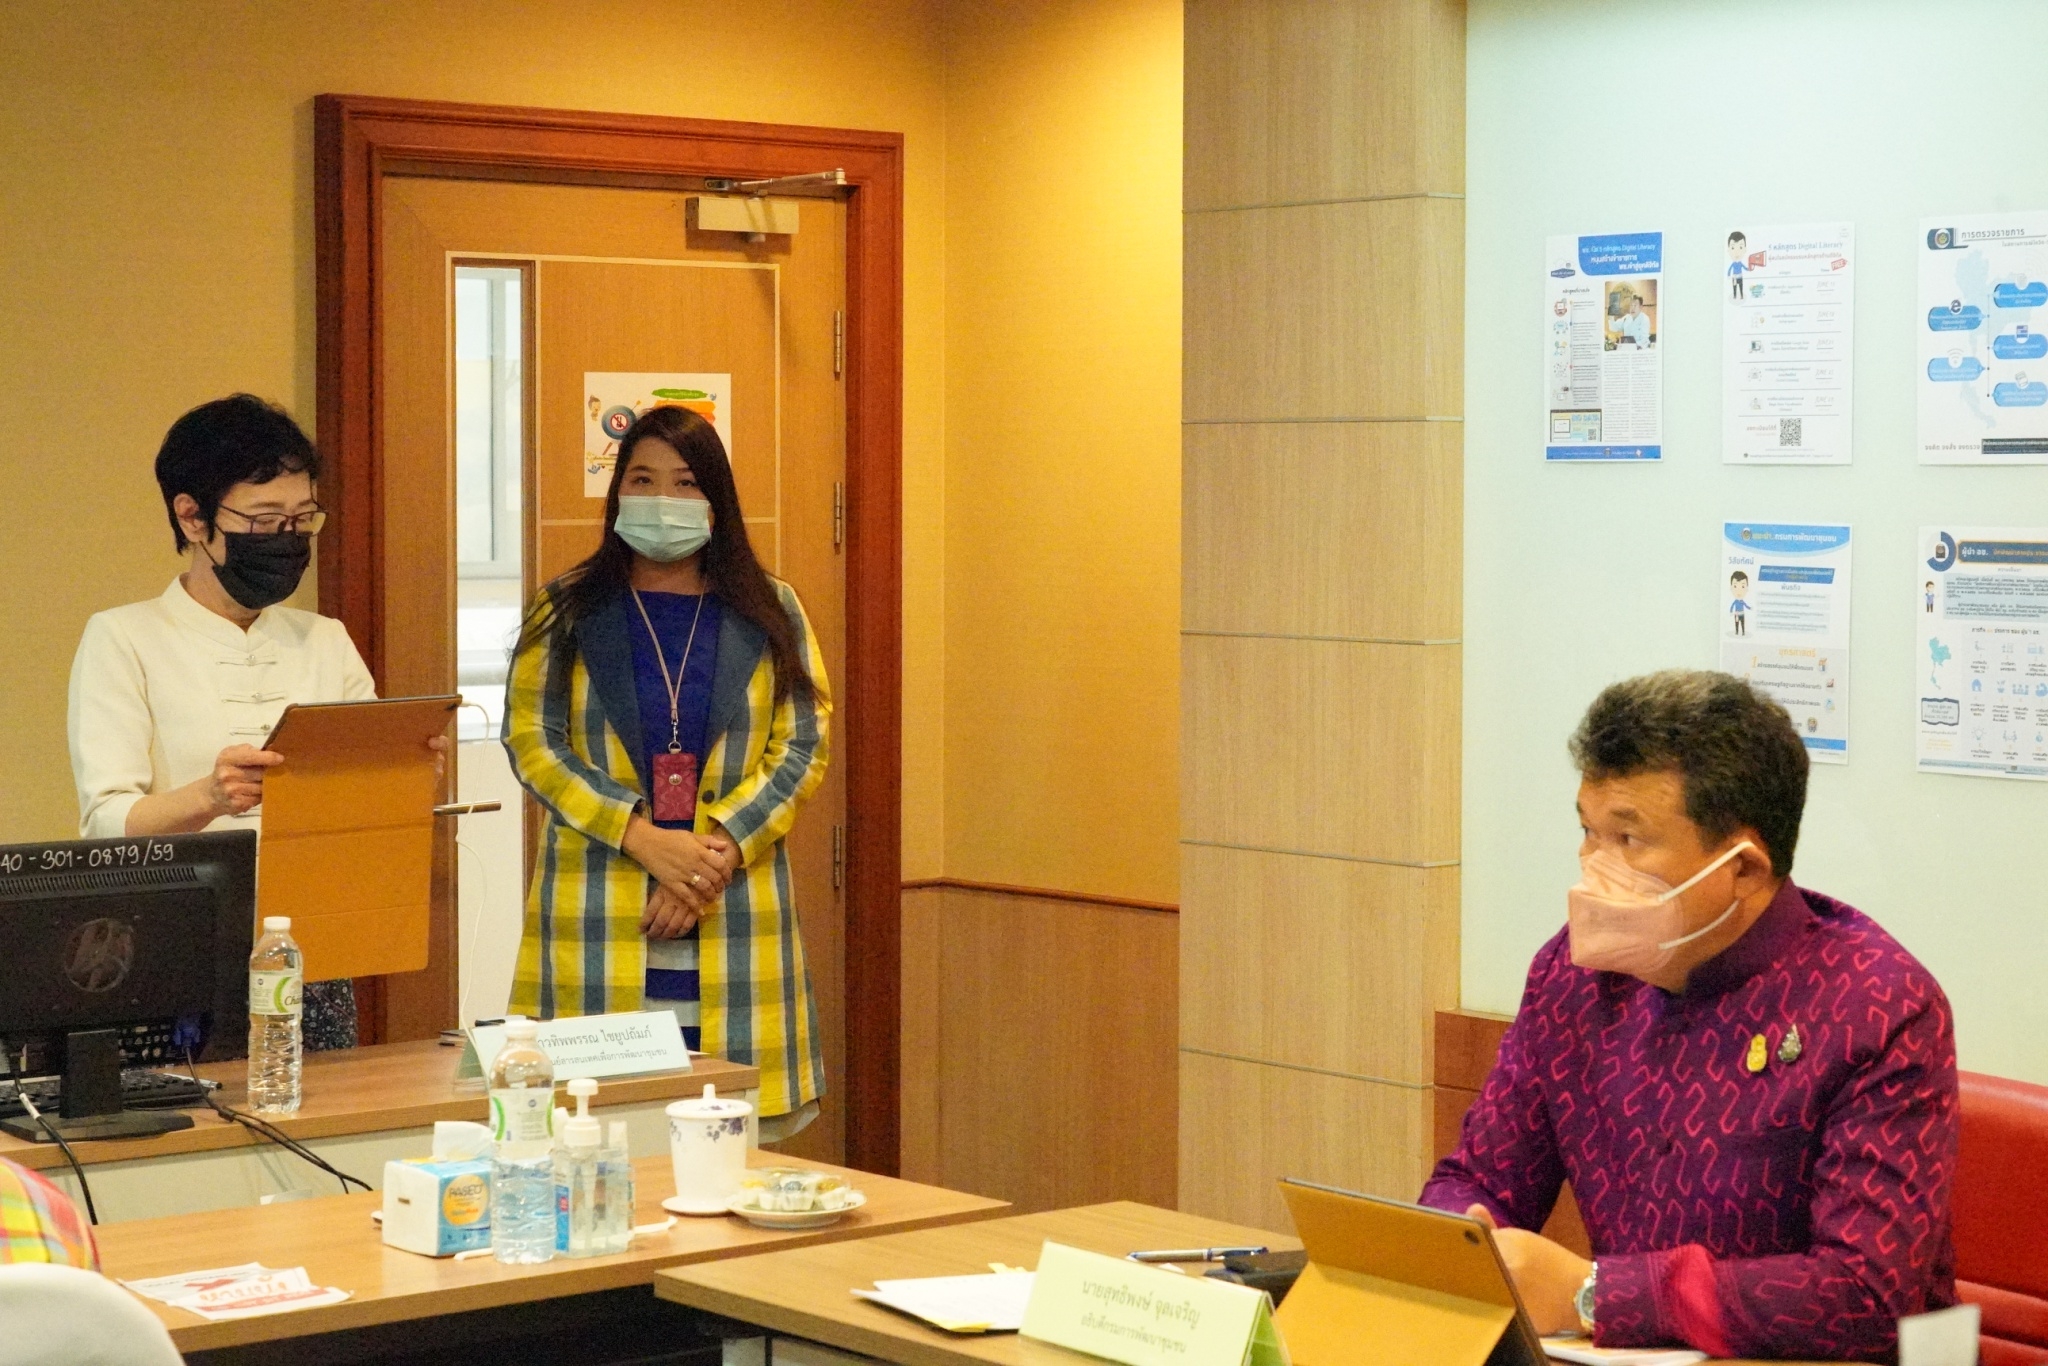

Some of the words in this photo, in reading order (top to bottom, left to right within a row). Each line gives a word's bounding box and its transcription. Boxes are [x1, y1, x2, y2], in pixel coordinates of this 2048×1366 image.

[538, 1033, 599, 1049] าวทิพพรรณ
[600, 1025, 652, 1046] ไชยูปถัมภ์
[551, 1048, 667, 1066] นย์สารสนเทศเพื่อการพัฒนาชุมชน
[448, 1184, 483, 1199] PASEO
[1082, 1279, 1153, 1312] นายสุทธิพงษ์
[1155, 1298, 1202, 1330] จุลเจริญ
